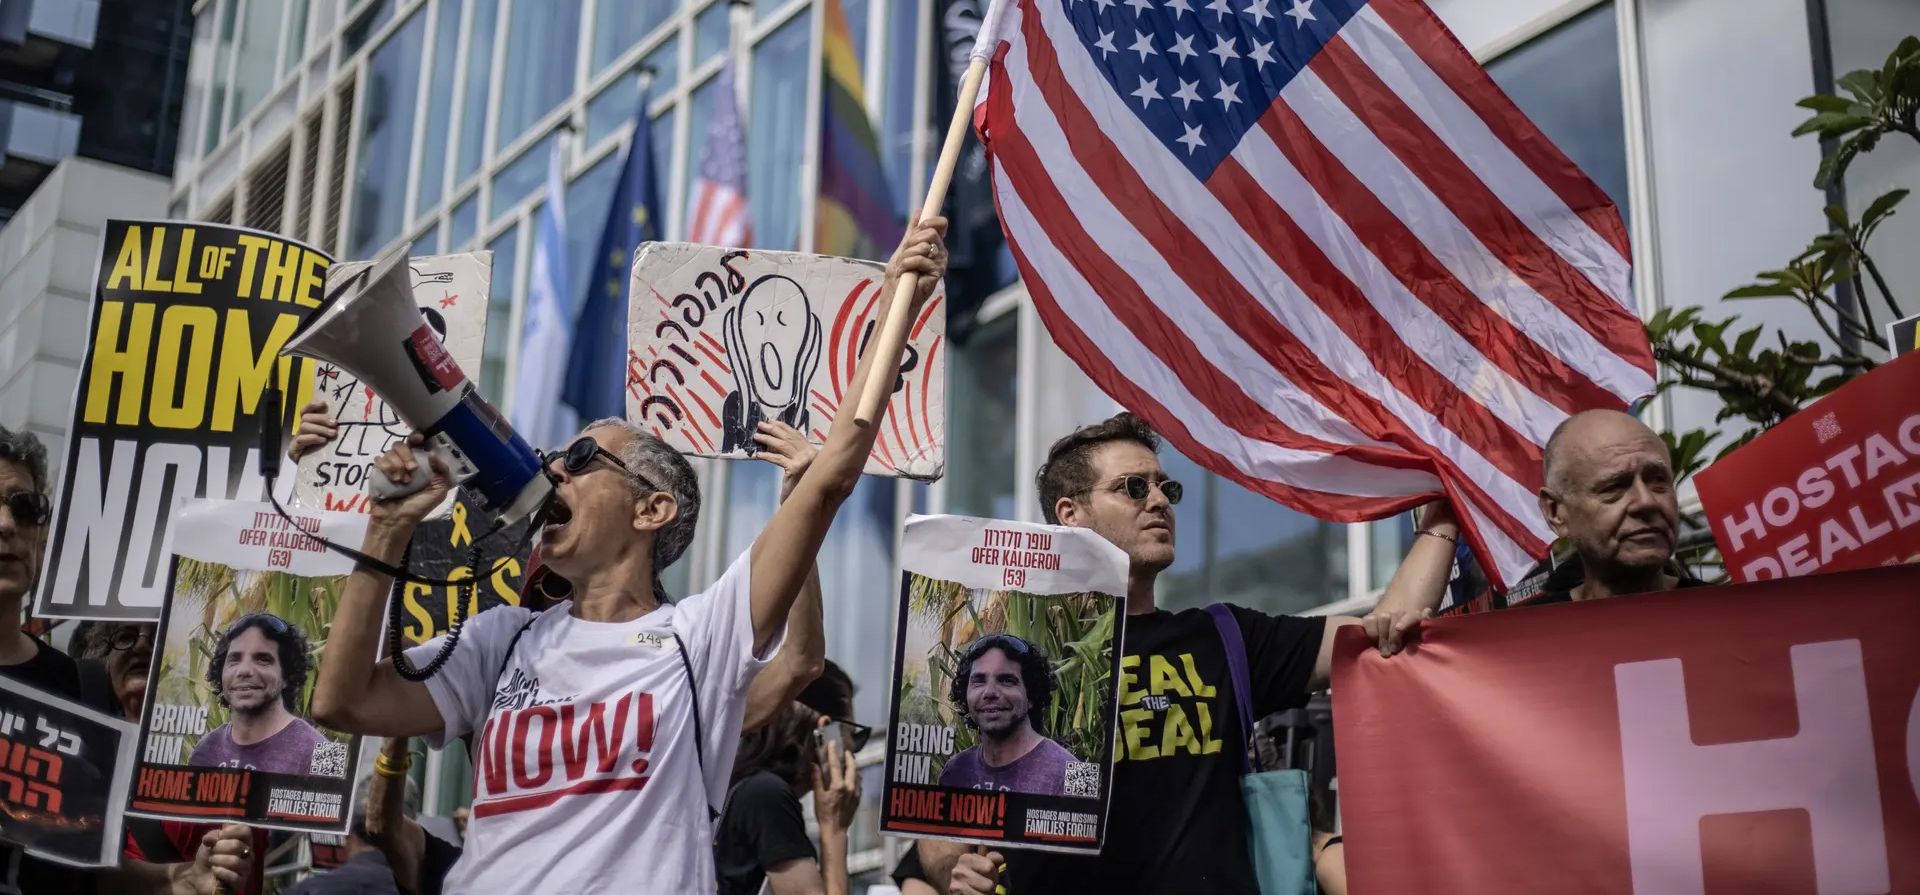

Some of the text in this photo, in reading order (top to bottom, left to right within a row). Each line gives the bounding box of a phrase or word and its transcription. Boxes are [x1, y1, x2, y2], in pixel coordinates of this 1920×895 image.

[106, 225, 330, 308] ALL OF THE
[83, 300, 316, 436] HOM
[239, 529, 266, 547] OFER
[983, 528, 1052, 550] עופר קלדרון
[267, 548, 292, 569] (53)
[971, 547, 1061, 571] OFER KALDERON
[1003, 568, 1026, 588] (53)
[638, 632, 662, 648] 249
[1119, 652, 1217, 705] EAL
[1142, 695, 1172, 711] THE
[151, 703, 208, 735] BRING
[0, 710, 82, 756] כל יו
[473, 691, 654, 800] NOW!
[895, 722, 956, 754] BRING
[143, 734, 184, 766] HIM
[893, 754, 932, 785] HIM
[137, 767, 251, 805] HOME NOW!
[270, 788, 342, 805] HOSTAGES AND MISSING
[267, 798, 341, 819] FAMILIES FORUM
[890, 787, 1006, 826] HOME NOW!
[1026, 808, 1098, 825] HOSTAGES AND MISSING
[1025, 818, 1097, 839] FAMILIES FORUM
